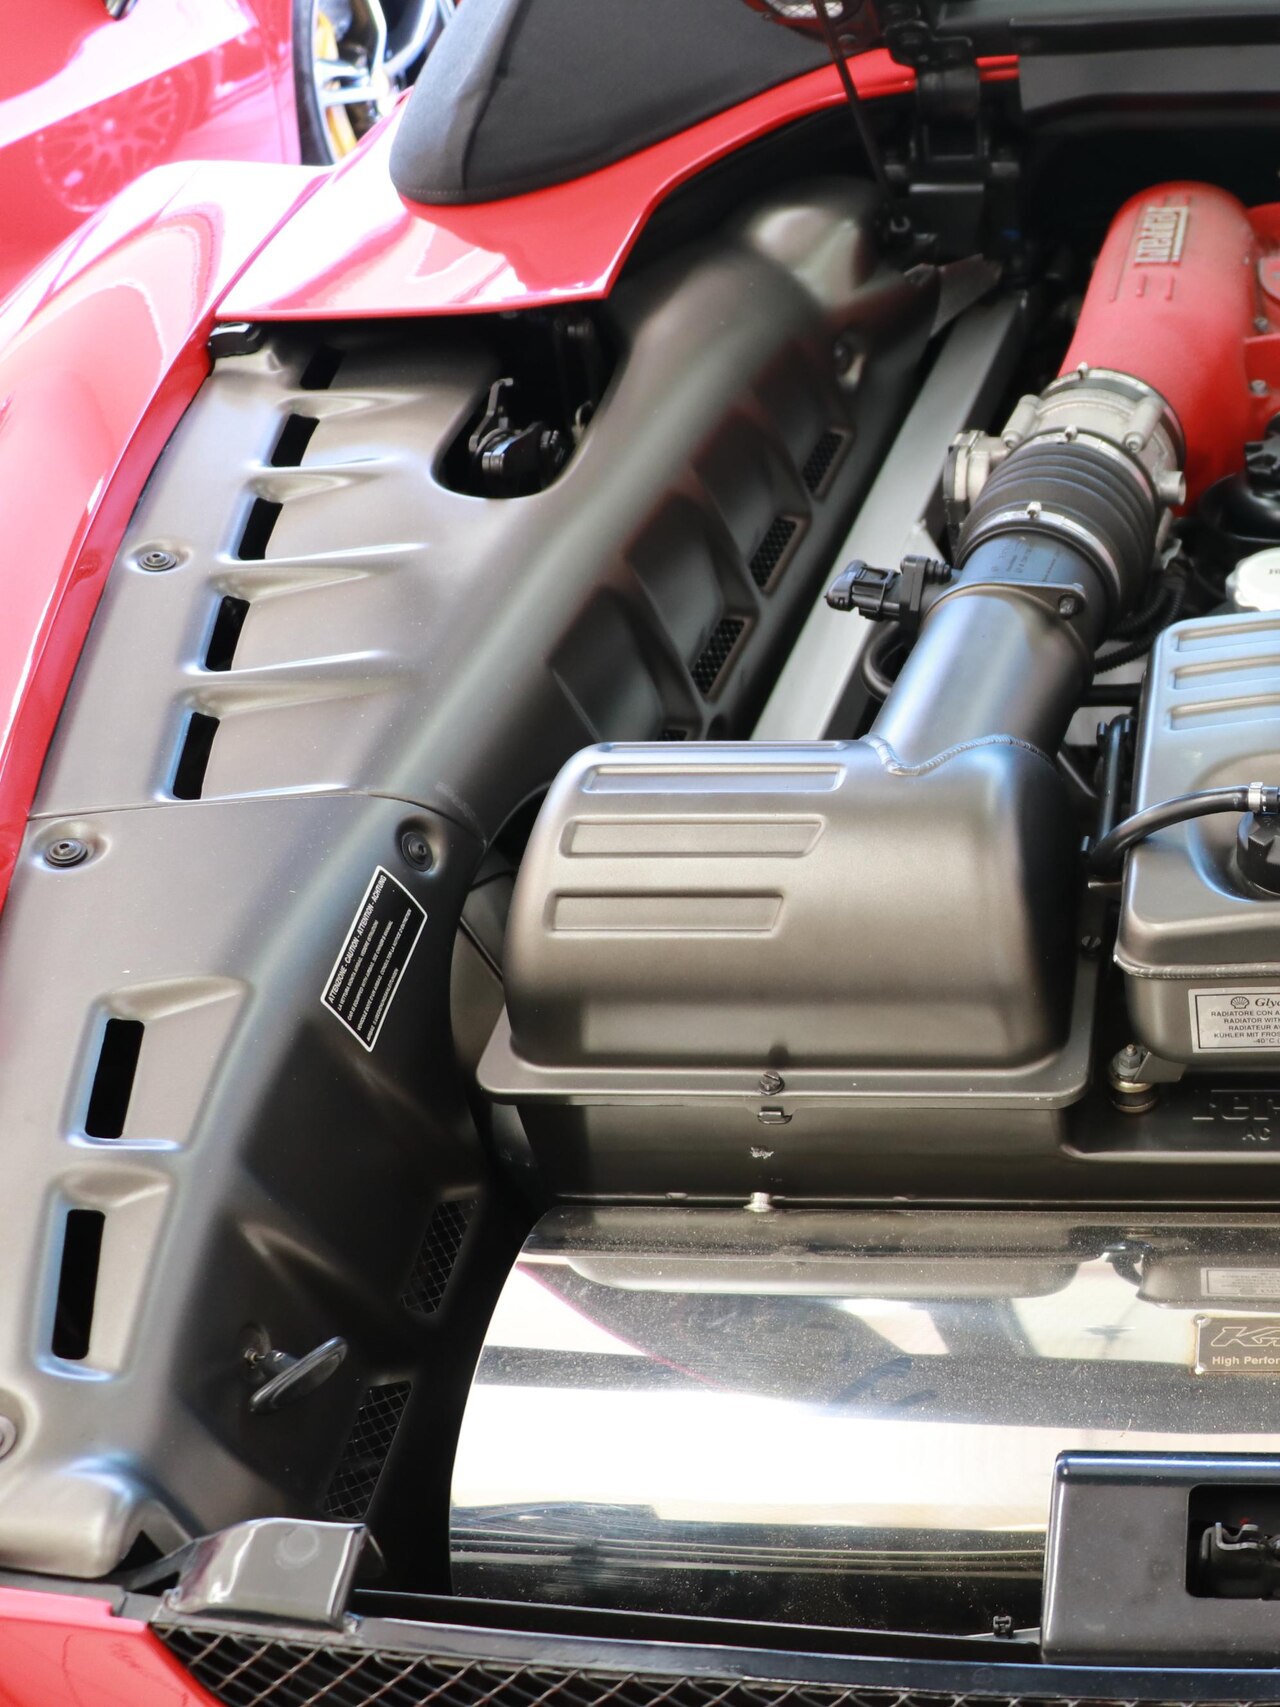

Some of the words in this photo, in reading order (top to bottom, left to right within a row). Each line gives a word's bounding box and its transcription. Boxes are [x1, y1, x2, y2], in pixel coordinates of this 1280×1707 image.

[328, 966, 347, 1003] ATTENZIONE
[345, 937, 359, 963] CAUTION
[357, 904, 374, 935] ATTENTION
[372, 875, 386, 902] ACHTUNG
[1242, 1126, 1270, 1141] AC
[1212, 1356, 1240, 1366] High
